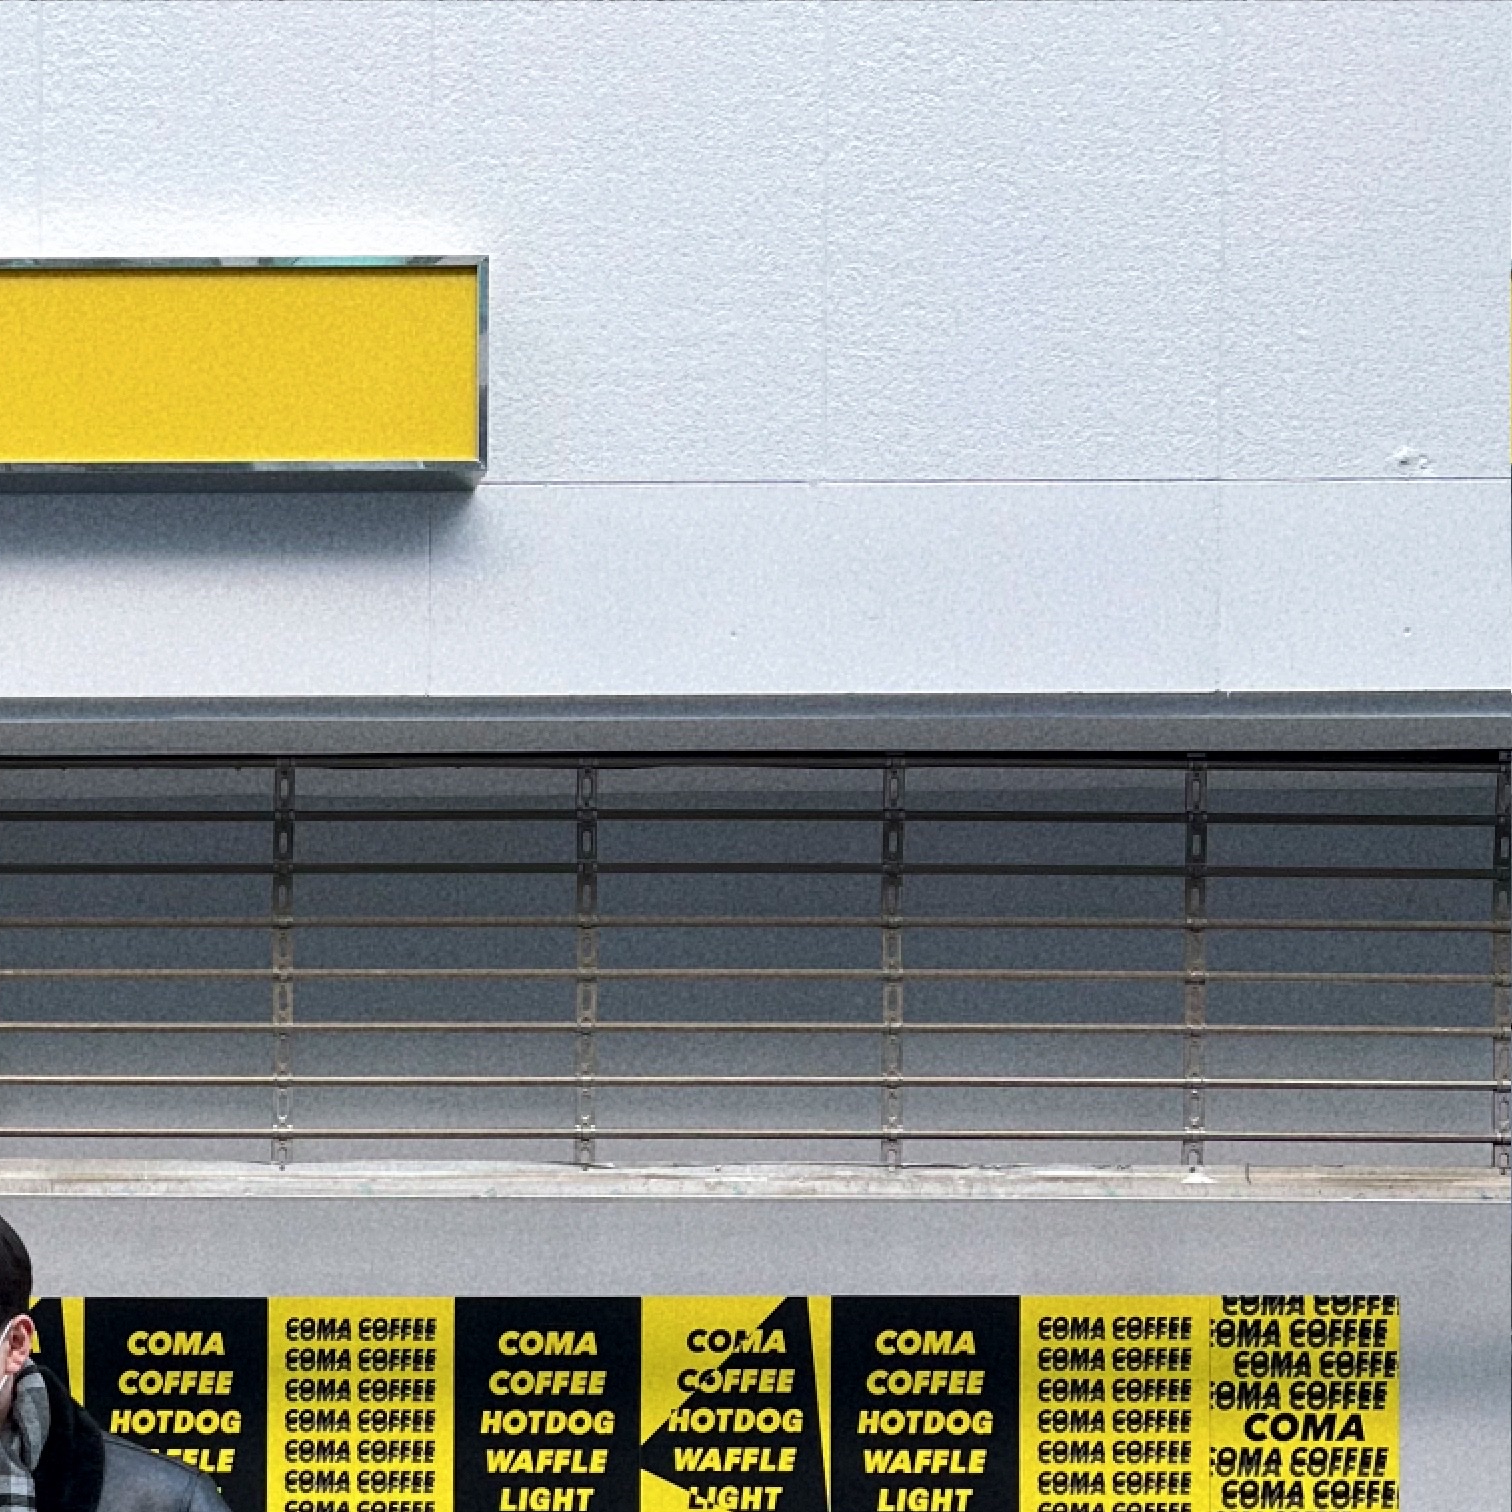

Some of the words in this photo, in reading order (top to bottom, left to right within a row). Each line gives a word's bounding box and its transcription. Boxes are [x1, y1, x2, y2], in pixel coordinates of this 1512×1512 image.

[1314, 1295, 1399, 1316] COFFE
[285, 1317, 351, 1342] COMA
[357, 1317, 436, 1342] COFFEE
[687, 1328, 787, 1353] COMA
[1038, 1316, 1106, 1341] COMA
[1112, 1316, 1192, 1341] COFFEE
[1289, 1318, 1387, 1348] COFFEE
[126, 1330, 226, 1355] COMA
[498, 1330, 598, 1355] COMA
[875, 1330, 976, 1355] COMA
[285, 1348, 351, 1372] COMA
[357, 1348, 436, 1372] COFFEE
[1038, 1347, 1106, 1372] COMA
[1112, 1347, 1192, 1372] COFFEE
[1233, 1350, 1311, 1378] COMA
[1319, 1350, 1399, 1378] COFFE
[118, 1370, 234, 1395] COFFEE
[285, 1378, 351, 1402] COMA
[357, 1378, 436, 1402] COFFEE
[488, 1370, 606, 1395] COFFEE
[676, 1368, 795, 1393] COFFEE
[866, 1370, 985, 1395] COFFEE
[1038, 1378, 1106, 1402] COMA
[1112, 1378, 1192, 1402] COFFEE
[1289, 1380, 1387, 1411] COFFEE
[110, 1408, 242, 1435] HOTDOG
[285, 1409, 351, 1433] COMA
[357, 1409, 436, 1433] COFFEE
[480, 1409, 615, 1435] HOTDOG
[668, 1407, 804, 1434] HOTDOG
[856, 1408, 993, 1435] HOTDOG
[1038, 1408, 1106, 1433] COMA
[1112, 1408, 1192, 1433] COFFEE
[1243, 1412, 1365, 1442] COMA
[285, 1439, 351, 1463] COMA
[357, 1439, 436, 1463] COFFEE
[486, 1448, 607, 1474] WAFFLE
[674, 1447, 797, 1472] WAFFLE
[864, 1448, 987, 1474] WAFFLE
[1038, 1440, 1106, 1464] COMA
[1112, 1440, 1192, 1464] COFFEE
[1289, 1446, 1389, 1477] COFFEE
[285, 1470, 351, 1494] COMA
[357, 1470, 436, 1494] COFFEE
[1038, 1470, 1106, 1496] COMA
[1112, 1470, 1192, 1496] COFFEE
[1221, 1479, 1304, 1509] COMA
[1313, 1479, 1399, 1509] COFFE
[500, 1487, 595, 1512] LIGHT
[688, 1485, 783, 1511] LIGHT
[876, 1488, 974, 1512] LIGHT
